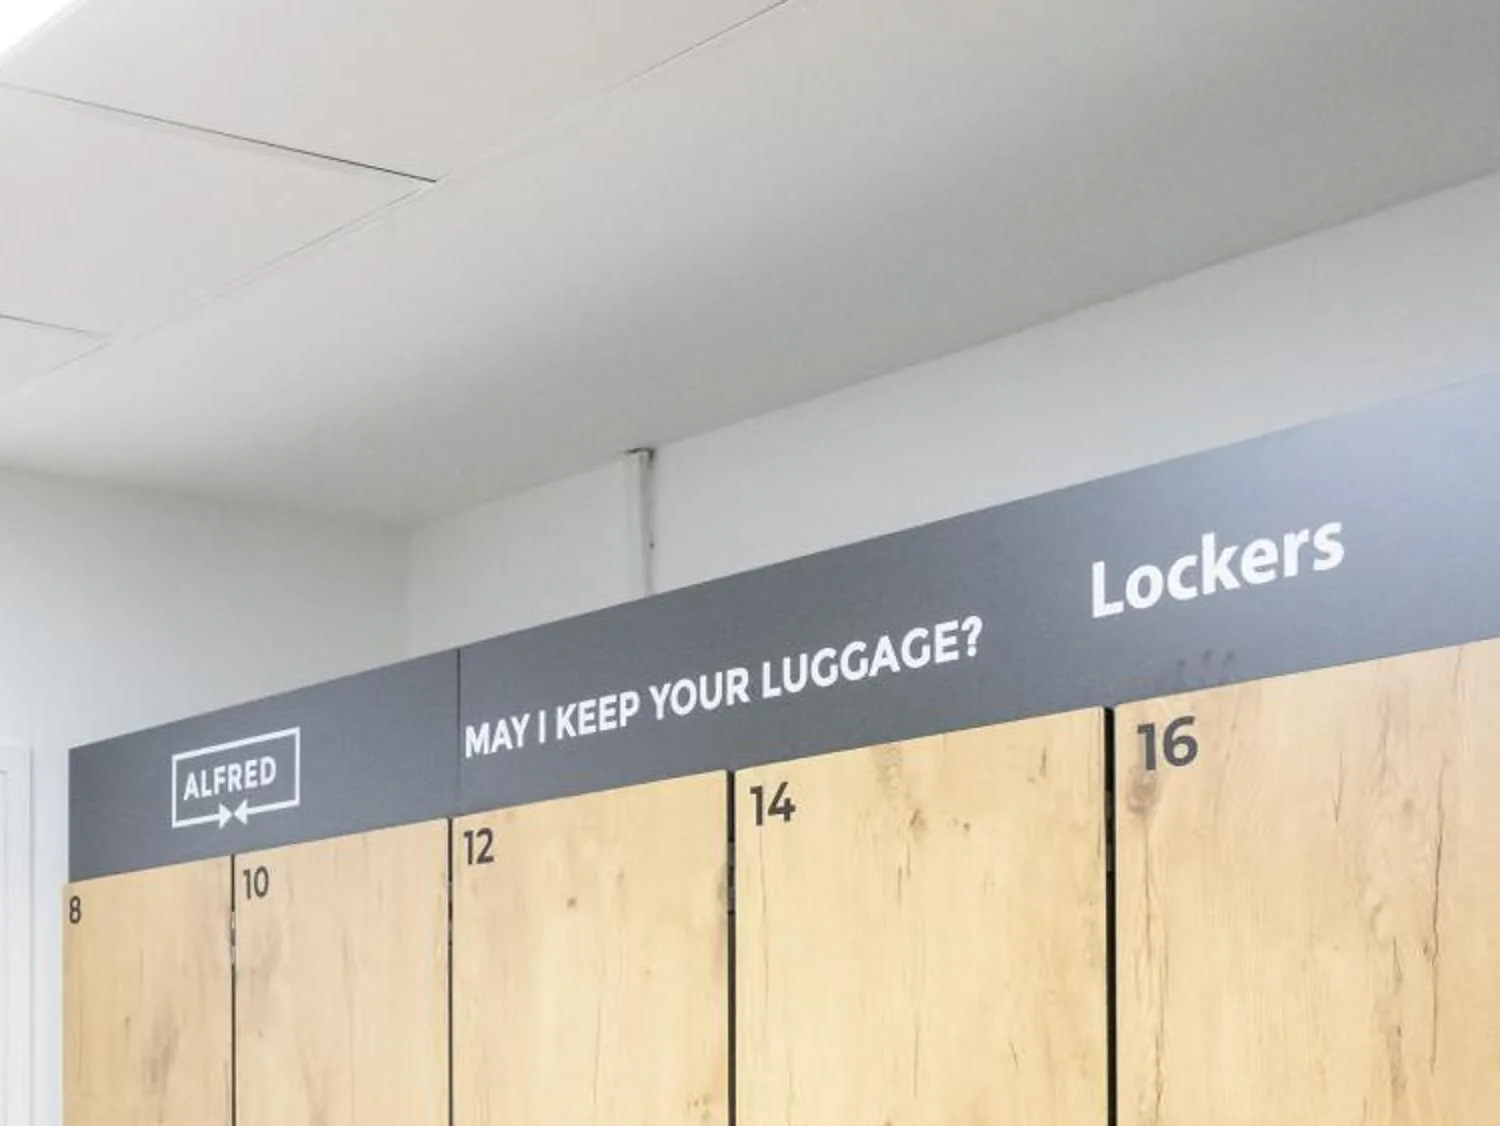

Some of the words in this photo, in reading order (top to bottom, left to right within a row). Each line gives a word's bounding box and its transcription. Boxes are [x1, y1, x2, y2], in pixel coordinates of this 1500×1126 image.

[1092, 521, 1346, 619] Lockers
[465, 714, 532, 760] MAY
[538, 714, 547, 746] I
[556, 691, 641, 741] KEEP
[649, 667, 751, 722] YOUR
[762, 615, 985, 700] LUGGAGE?
[1136, 716, 1199, 772] 16
[184, 756, 278, 802] ALFRED
[750, 782, 797, 828] 14
[463, 828, 496, 867] 12
[243, 866, 271, 901] 10
[69, 896, 83, 926] 8
